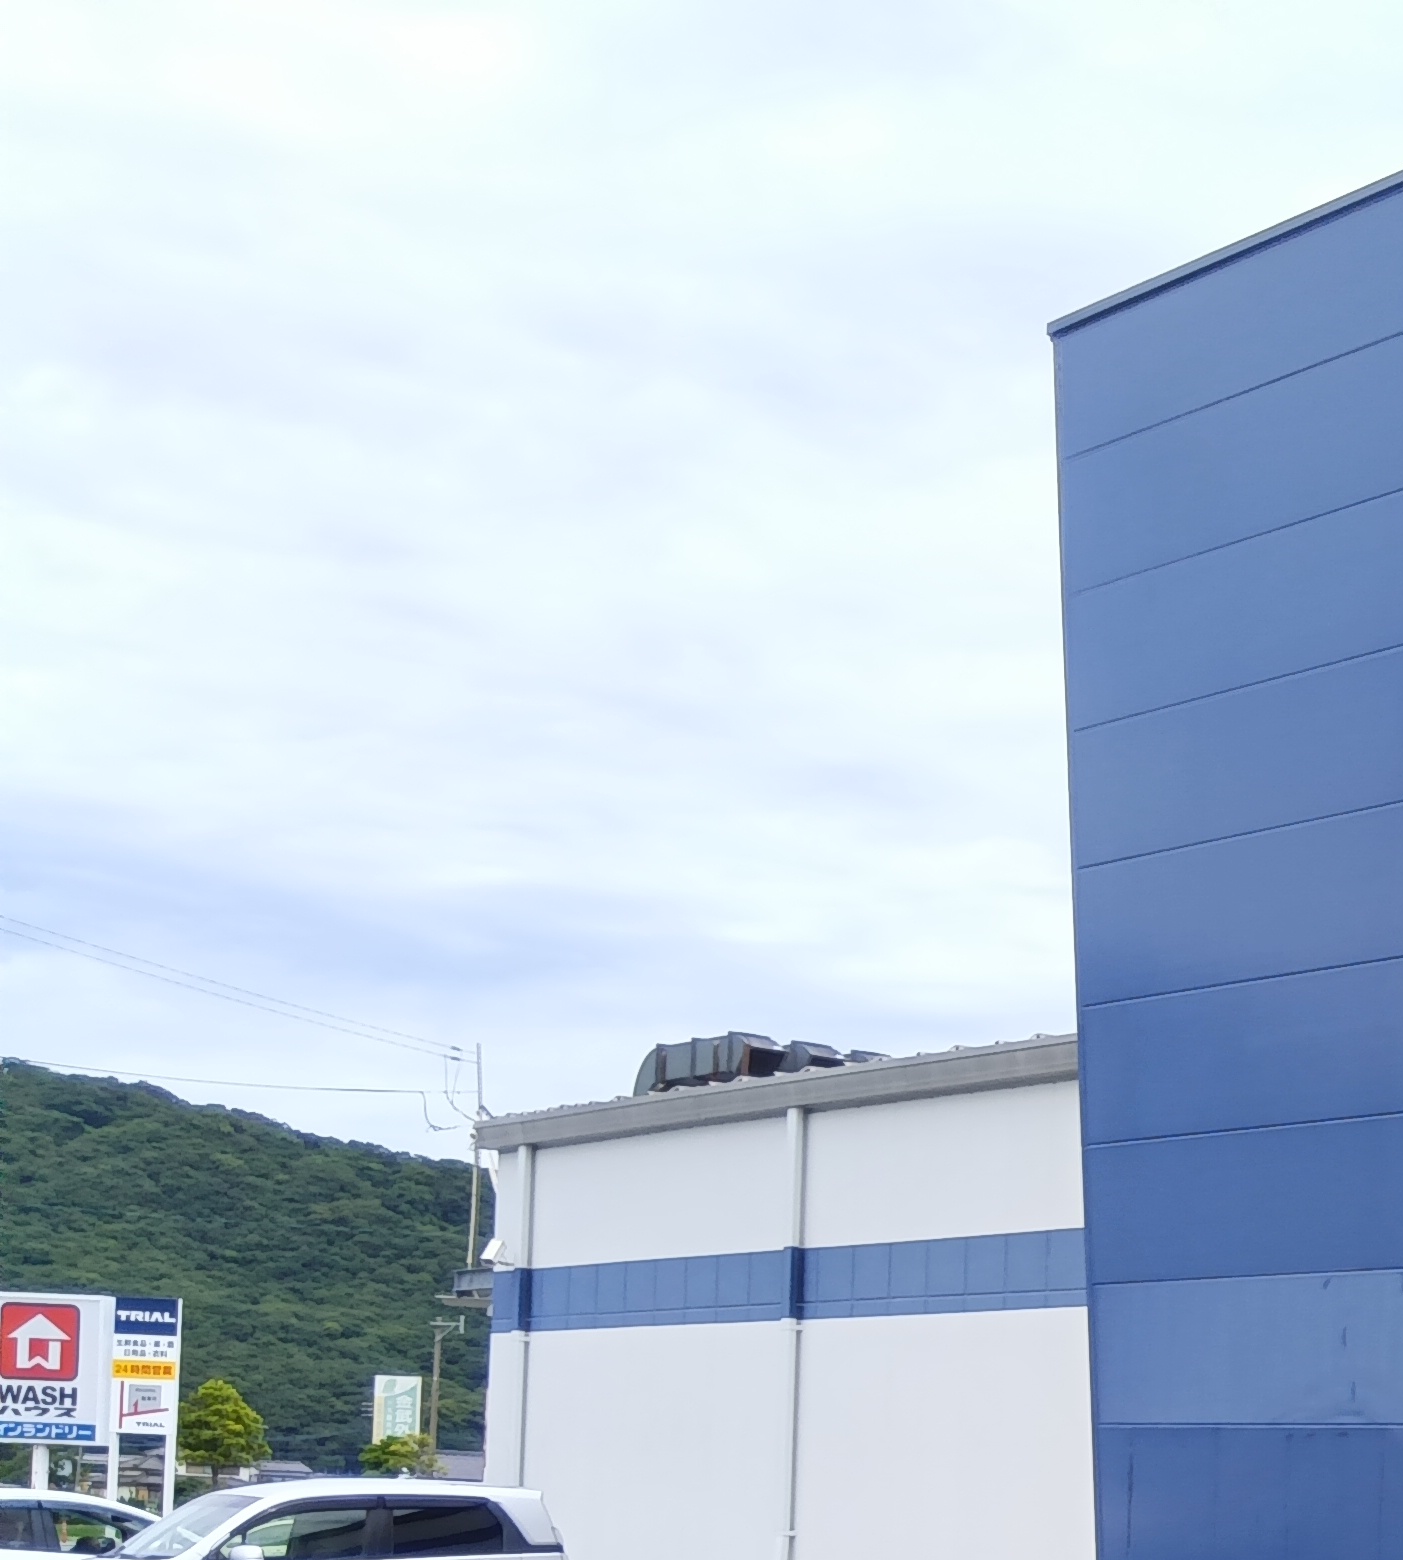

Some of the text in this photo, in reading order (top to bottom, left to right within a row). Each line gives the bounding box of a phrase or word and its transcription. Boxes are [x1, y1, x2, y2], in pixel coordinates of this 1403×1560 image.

[117, 1310, 176, 1323] TRIAL
[114, 1363, 173, 1376] 24時間営業
[0, 1384, 78, 1407] WASH
[0, 1405, 77, 1418] ハウス
